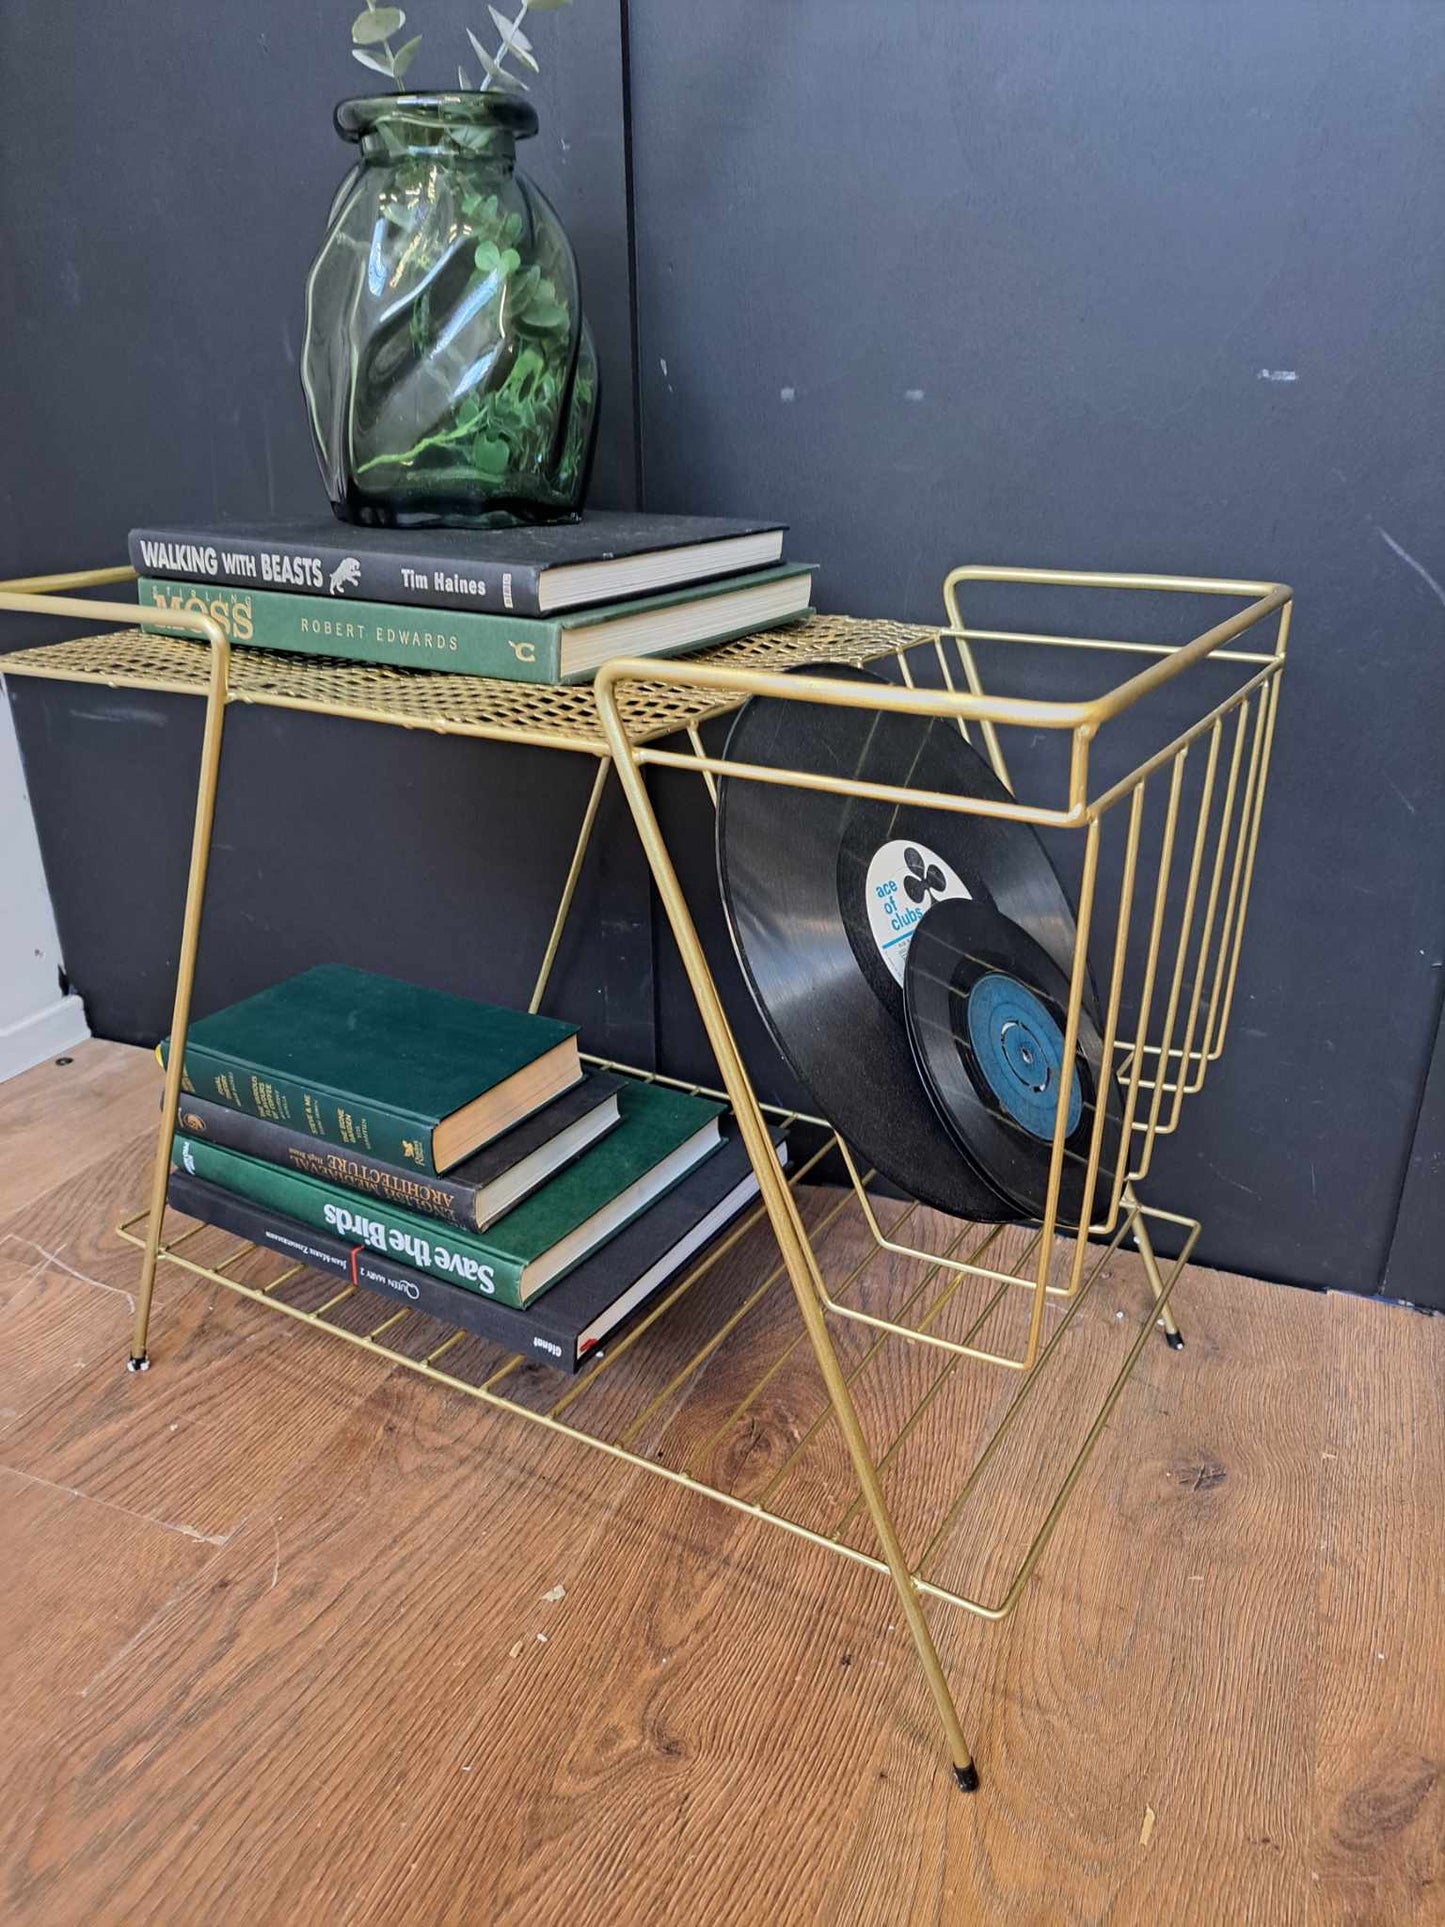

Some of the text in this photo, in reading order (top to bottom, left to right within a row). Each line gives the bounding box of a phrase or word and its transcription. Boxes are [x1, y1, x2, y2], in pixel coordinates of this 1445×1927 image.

[140, 540, 323, 587] WALKING WITH BEASTS
[401, 568, 487, 596] Tim Haines
[301, 618, 458, 651] ROBERT EDWARDS
[876, 880, 898, 898] ace
[884, 896, 898, 915] of
[891, 906, 922, 931] clubs
[326, 1154, 454, 1207] ARCHITECTURE
[323, 1204, 495, 1294] Save the Birds
